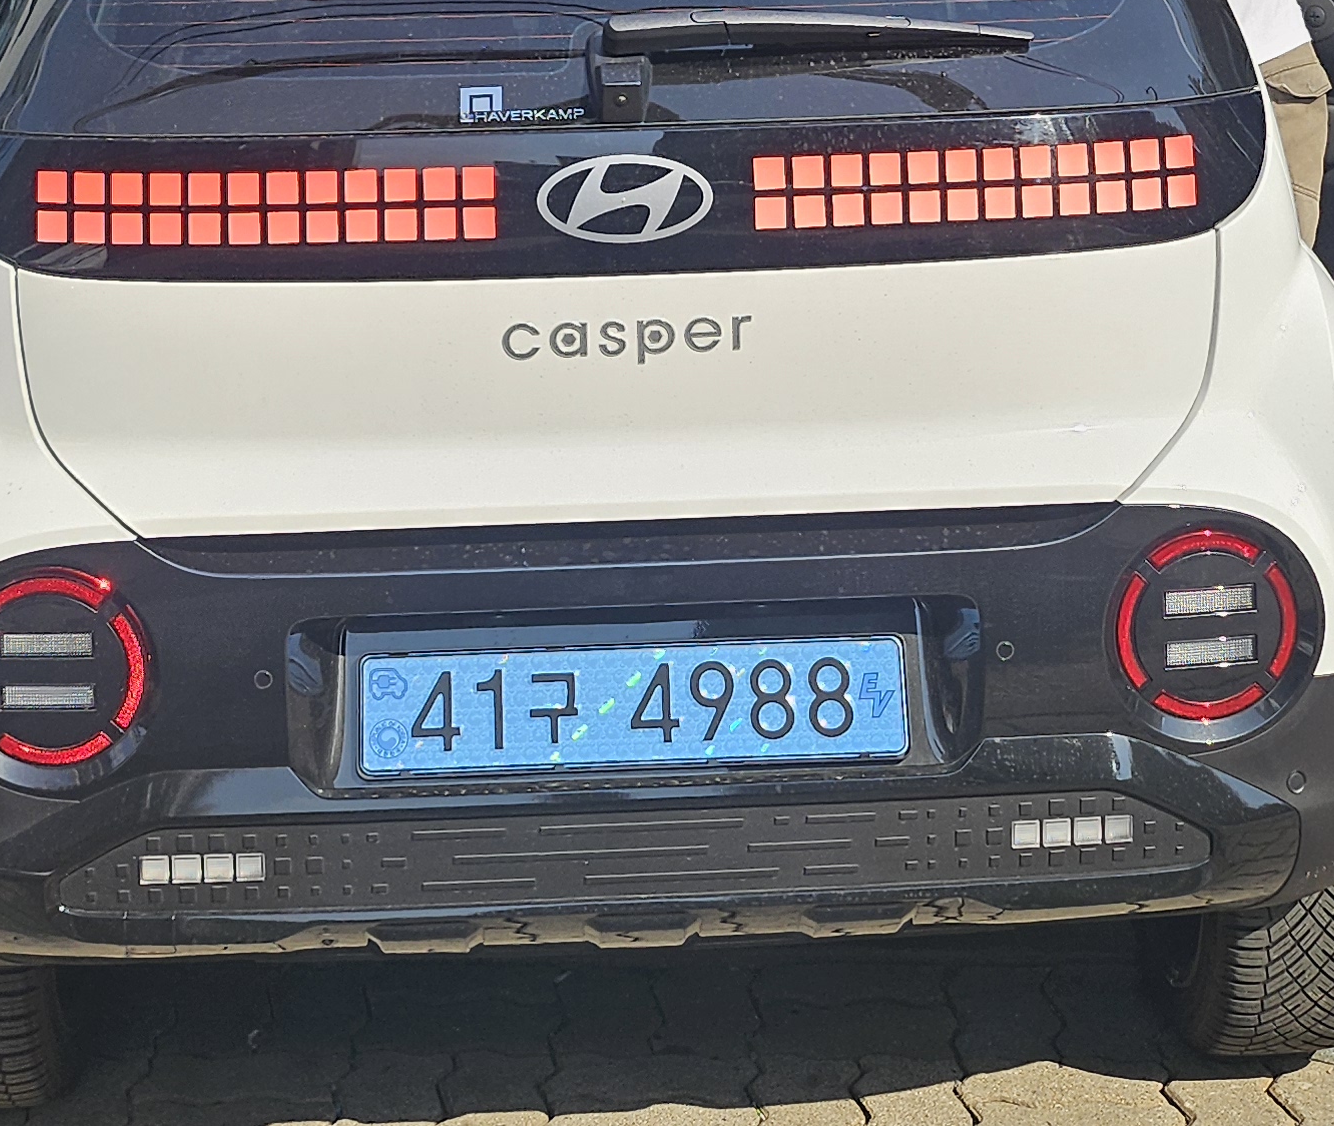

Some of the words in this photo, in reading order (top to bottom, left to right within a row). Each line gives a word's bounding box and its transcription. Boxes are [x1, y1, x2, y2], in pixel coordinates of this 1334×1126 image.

[474, 107, 585, 123] HAVERKAMP
[502, 316, 752, 365] casper
[411, 668, 579, 752] 41구
[630, 656, 855, 742] 4988
[858, 672, 896, 718] EV
